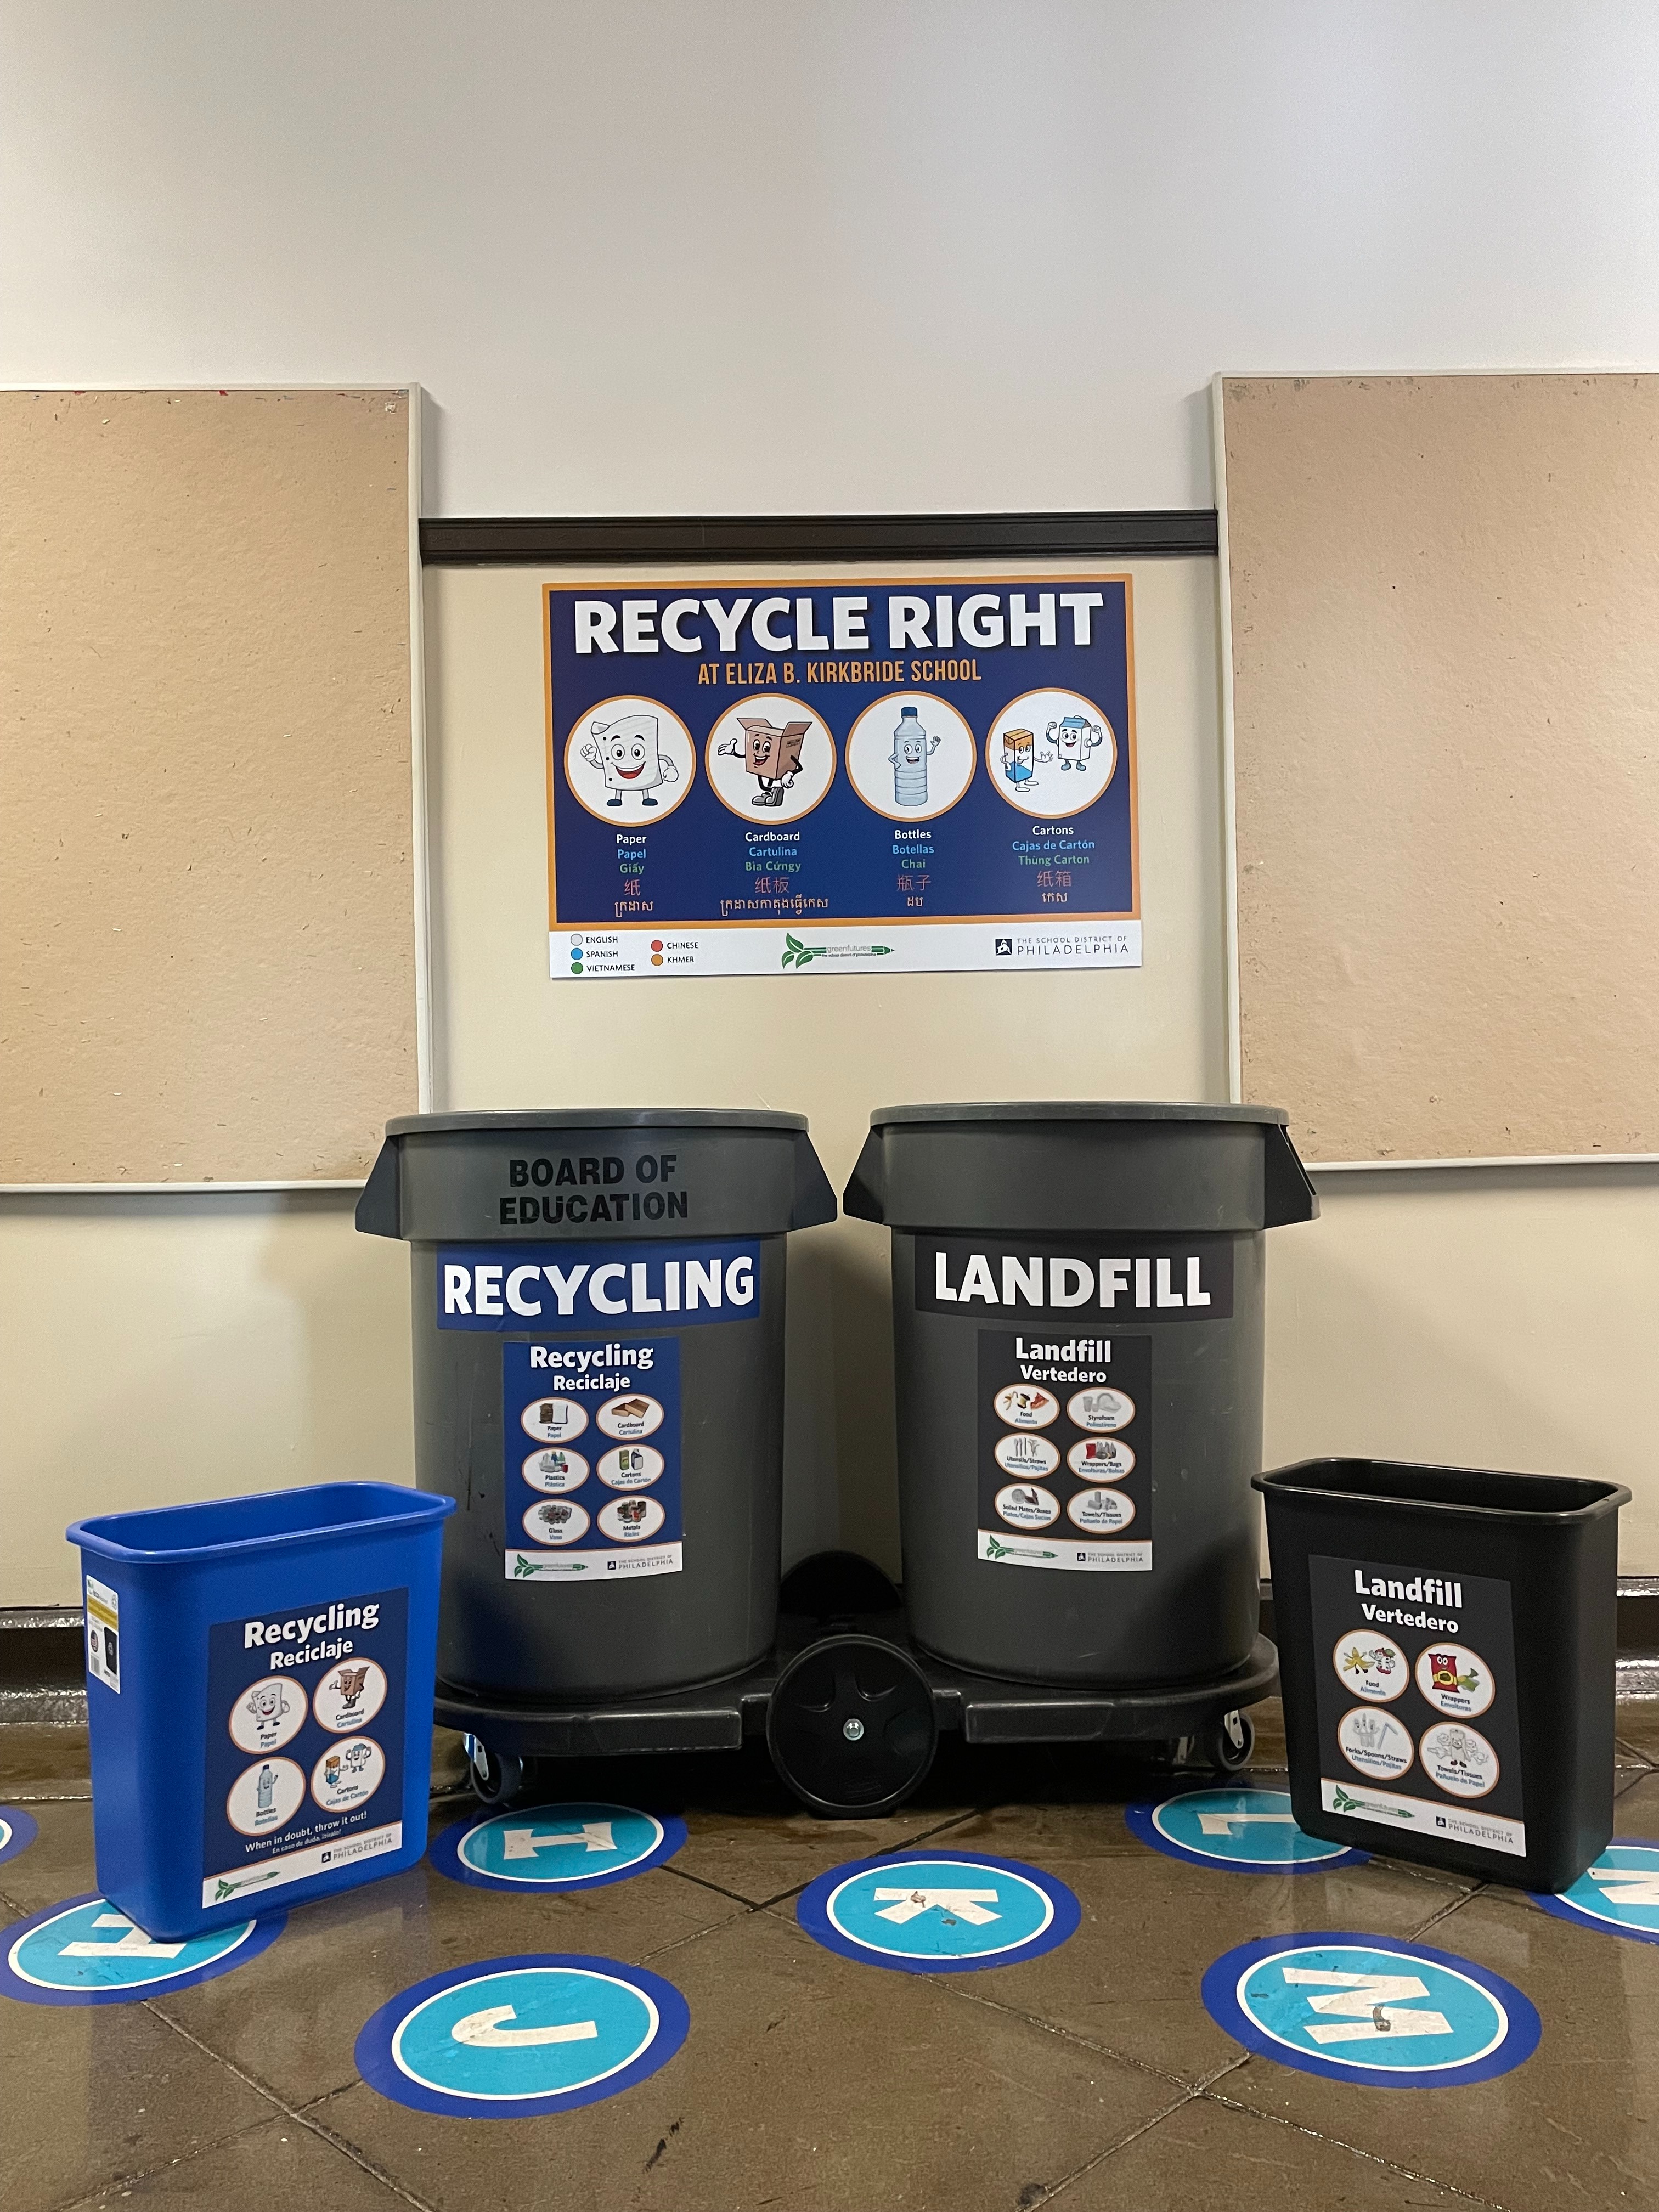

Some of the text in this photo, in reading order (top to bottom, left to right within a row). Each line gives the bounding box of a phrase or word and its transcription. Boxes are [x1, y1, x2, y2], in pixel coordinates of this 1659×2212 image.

[574, 592, 1104, 653] RECYCLE RIGHT
[698, 659, 981, 685] AT ELIZA B. KIRKBRIDE SCHOOL
[745, 831, 800, 842] Cardboard
[895, 829, 932, 839] Bottles
[1032, 825, 1074, 835] Cartons
[616, 834, 647, 845] Paper
[1012, 839, 1094, 852] Cajas de Cartón
[618, 849, 646, 860] Papel
[749, 847, 797, 856] Cartulina
[893, 844, 934, 854] Botellas
[620, 862, 644, 875] Giấy
[901, 859, 926, 868] Chai
[1018, 855, 1090, 866] Thùng Carton
[755, 877, 789, 894] 纸板
[896, 874, 932, 891] 瓶子
[1037, 870, 1071, 887] 纸箱
[624, 879, 641, 896] 纸
[827, 944, 871, 953] greenfutures
[1017, 944, 1128, 955] PHILADELPHIA
[510, 1154, 678, 1187] BOARD OF
[499, 1190, 689, 1225] EDUCATION
[443, 1256, 755, 1316] RECYCLING
[935, 1252, 1211, 1308] LANDFILL
[530, 1343, 654, 1373] Recycling
[1015, 1337, 1111, 1363] Landfill
[1020, 1364, 1107, 1383] Vertedero
[554, 1373, 631, 1392] Reciclaje
[618, 1559, 673, 1569] PHILADELPHIA
[1354, 1569, 1463, 1609] Landfill
[245, 1603, 380, 1649] Recycling
[1361, 1603, 1459, 1633] Vertedero
[270, 1638, 353, 1670] Reciclaje
[1441, 1693, 1470, 1705] Wrappers
[1346, 1746, 1407, 1763] Forks/Spoons/Straws
[245, 1811, 367, 1853] When in doubt, throw it out!
[1448, 1823, 1514, 1844] PHILADELPHIA
[333, 1838, 392, 1860] PHILADELPHIA
[873, 1887, 1002, 1926] K
[452, 2004, 599, 2048] J
